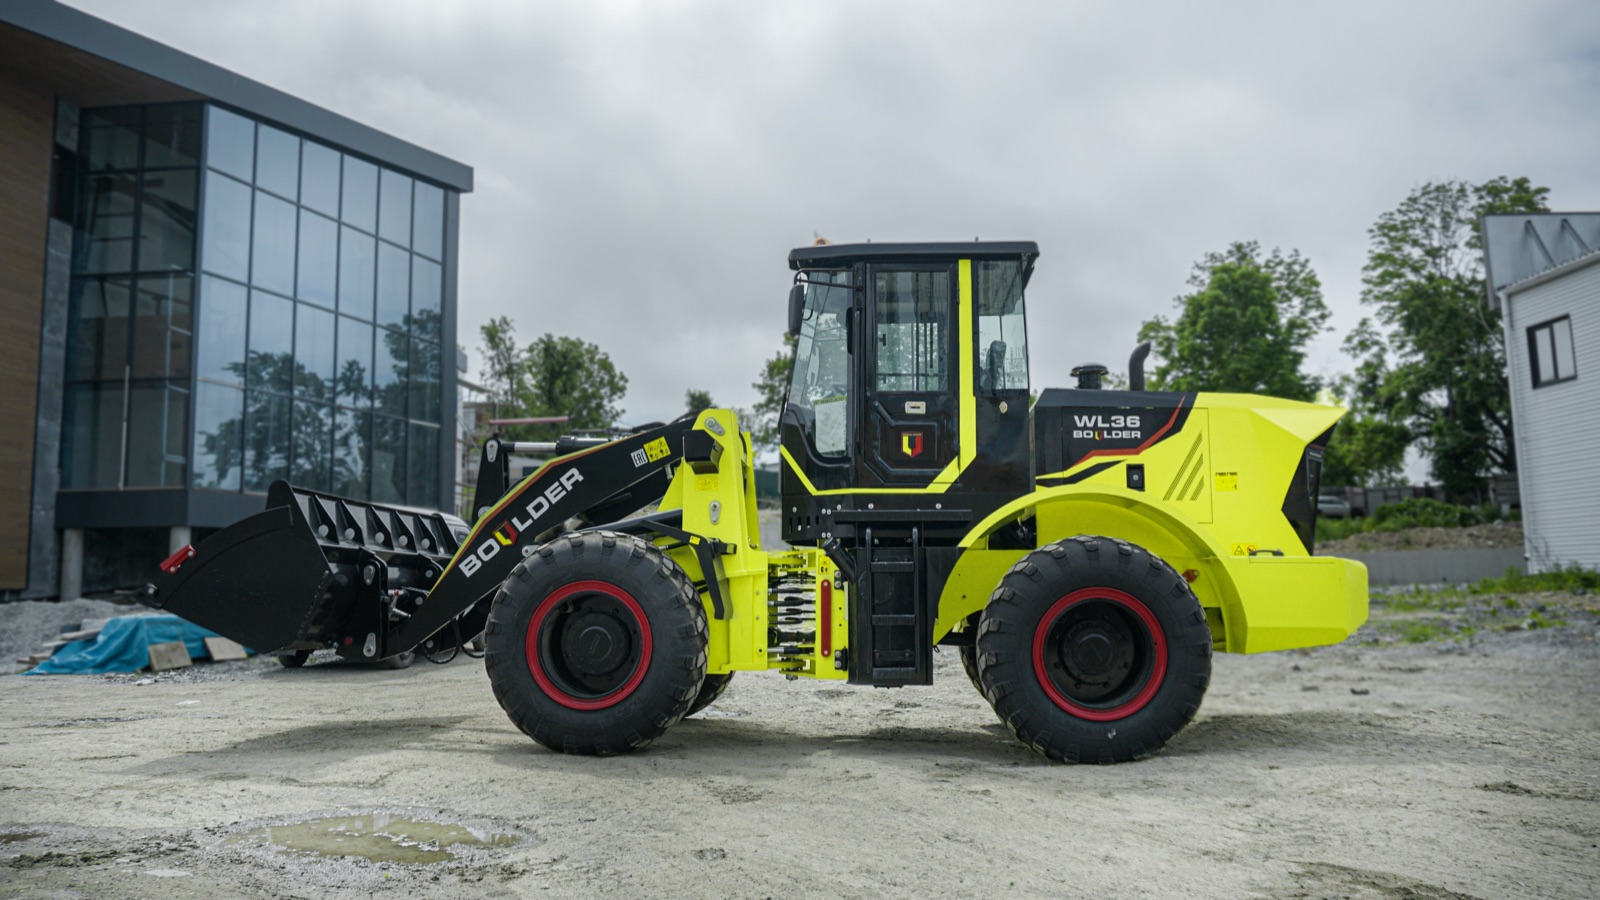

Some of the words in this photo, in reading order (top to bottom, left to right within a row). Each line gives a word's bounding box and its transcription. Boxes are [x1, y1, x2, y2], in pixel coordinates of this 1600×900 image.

[1073, 415, 1141, 428] WL36
[1073, 430, 1141, 440] BOULDER
[459, 467, 584, 578] BOULDER
